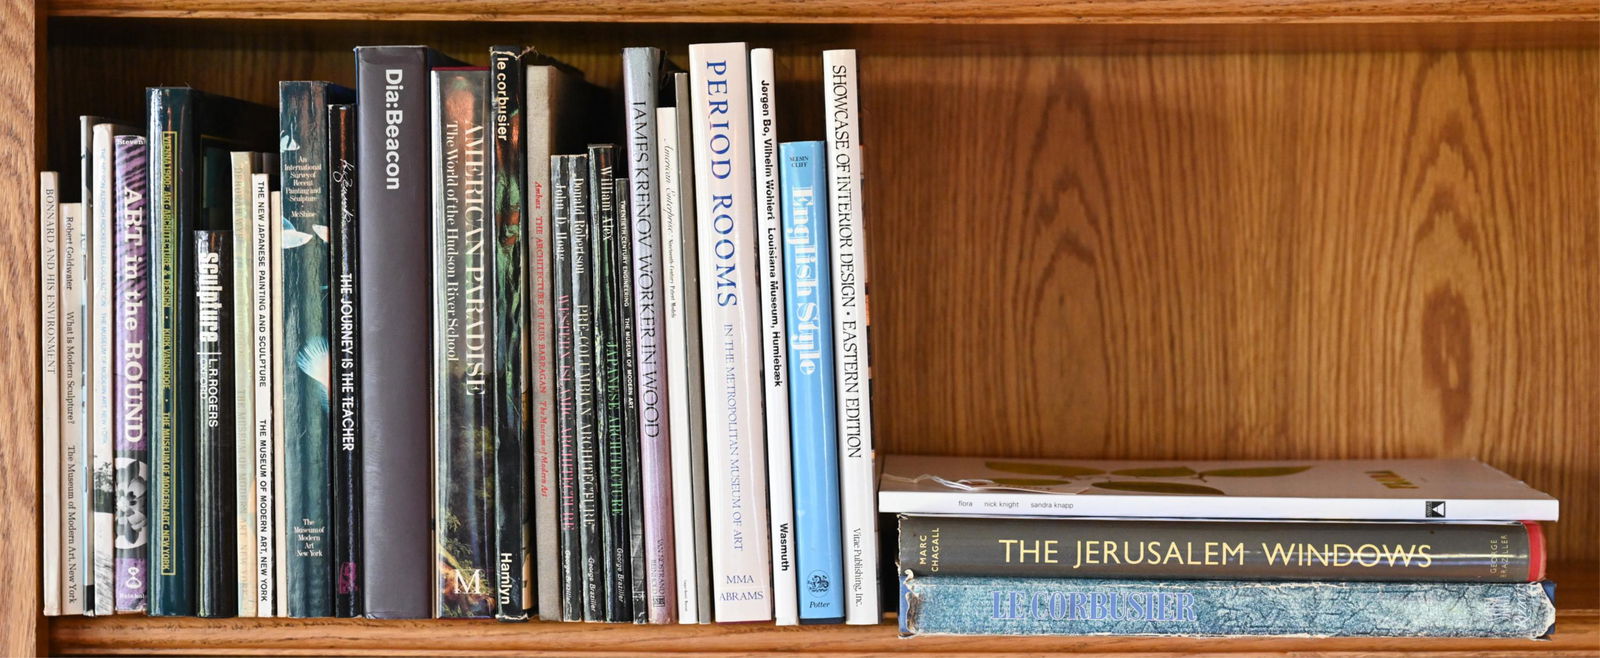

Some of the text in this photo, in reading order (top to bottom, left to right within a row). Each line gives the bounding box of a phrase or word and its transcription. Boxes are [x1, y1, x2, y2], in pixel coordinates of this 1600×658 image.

[497, 57, 511, 142] le corbusier
[758, 80, 771, 116] Jørgen
[162, 135, 172, 164] VIENNA
[386, 69, 405, 190] Dia:Beacon
[761, 119, 772, 136] Bo,
[663, 143, 674, 184] American
[763, 137, 774, 177] Vilhelm
[555, 183, 567, 210] John
[599, 166, 614, 242] William Alex
[705, 60, 738, 309] PERIOD ROOMS
[446, 121, 459, 362] The World of the Hudson River School
[535, 216, 544, 236] THE
[574, 178, 588, 275] Donald Robertson
[65, 216, 74, 291] Robert Goldwater
[464, 120, 487, 397] AMERICAN PARADISE
[536, 237, 545, 306] ARCHITECTURE
[620, 200, 630, 307] TWENTIETH CENTURY ENGINEERING
[632, 100, 661, 439] JAMES KRENOV WORKER IN WOOD
[766, 226, 778, 278] Louisiana
[831, 64, 863, 459] SHOWCASE OF INTERIOR DESIGN EASTERN EDITION
[45, 188, 56, 375] BONNARD AND HIS ENVIRONMENT
[163, 278, 172, 308] DESIGN
[196, 251, 223, 343] sculpture
[257, 181, 267, 389] THE NEW JAPANESE PAINTING AND SCULPTURE
[784, 185, 822, 376] English Style
[123, 185, 144, 443] ART in the ROUND
[536, 308, 545, 319] OF
[769, 280, 780, 329] Museum,
[162, 328, 172, 347] KIRK
[537, 321, 546, 342] LUIS
[624, 331, 632, 358] MUSEUM
[64, 311, 76, 425] What Is Modern Sculpture?
[200, 357, 209, 401] OXFORD
[339, 271, 356, 452] THE JOURNEY IS THE TEACHER
[538, 343, 548, 395] BARRAGAN
[626, 359, 632, 368] OF
[207, 357, 219, 429] L.R.ROGERS
[558, 294, 576, 532] WESTERN ISLAMIC ARCHITECTURE
[162, 412, 171, 428] THE
[576, 303, 596, 528] PRE-COLUMBIAN ARCHITECTURE
[606, 341, 624, 517] JAPANESE ARCHITECTURE
[67, 445, 76, 463] The
[162, 429, 171, 463] MUSEUM
[722, 324, 744, 552] IN THE METROPOLITAN MUSEUM OF ART
[67, 464, 76, 499] Museum
[162, 465, 171, 475] OF
[67, 501, 77, 511] of
[162, 476, 171, 509] MODERN
[259, 419, 269, 603] THE MUSEUM OF MODERN ART, NEW YORK
[957, 499, 974, 508] flora
[998, 501, 1019, 511] knight
[1029, 501, 1075, 512] sandra knapp
[67, 512, 77, 543] Modern
[779, 522, 791, 572] Wasmuth
[931, 527, 940, 572] CHAGALL
[162, 549, 172, 570] YORK
[852, 527, 866, 608] Vitae Publishing, Inc.
[919, 535, 927, 565] MARC
[997, 540, 1434, 569] THE JERUSALEM WINDOWS
[1489, 539, 1498, 574] GEORGE
[68, 563, 77, 583] New
[68, 584, 77, 604] York
[498, 553, 513, 605] Hamlyn
[587, 557, 598, 613] George Braziller
[615, 547, 626, 604] George Braziller
[725, 575, 754, 584] MMA
[719, 591, 764, 601] ABRAMS
[809, 600, 831, 609] Potter
[990, 590, 1199, 622] LE CORBUSIER
